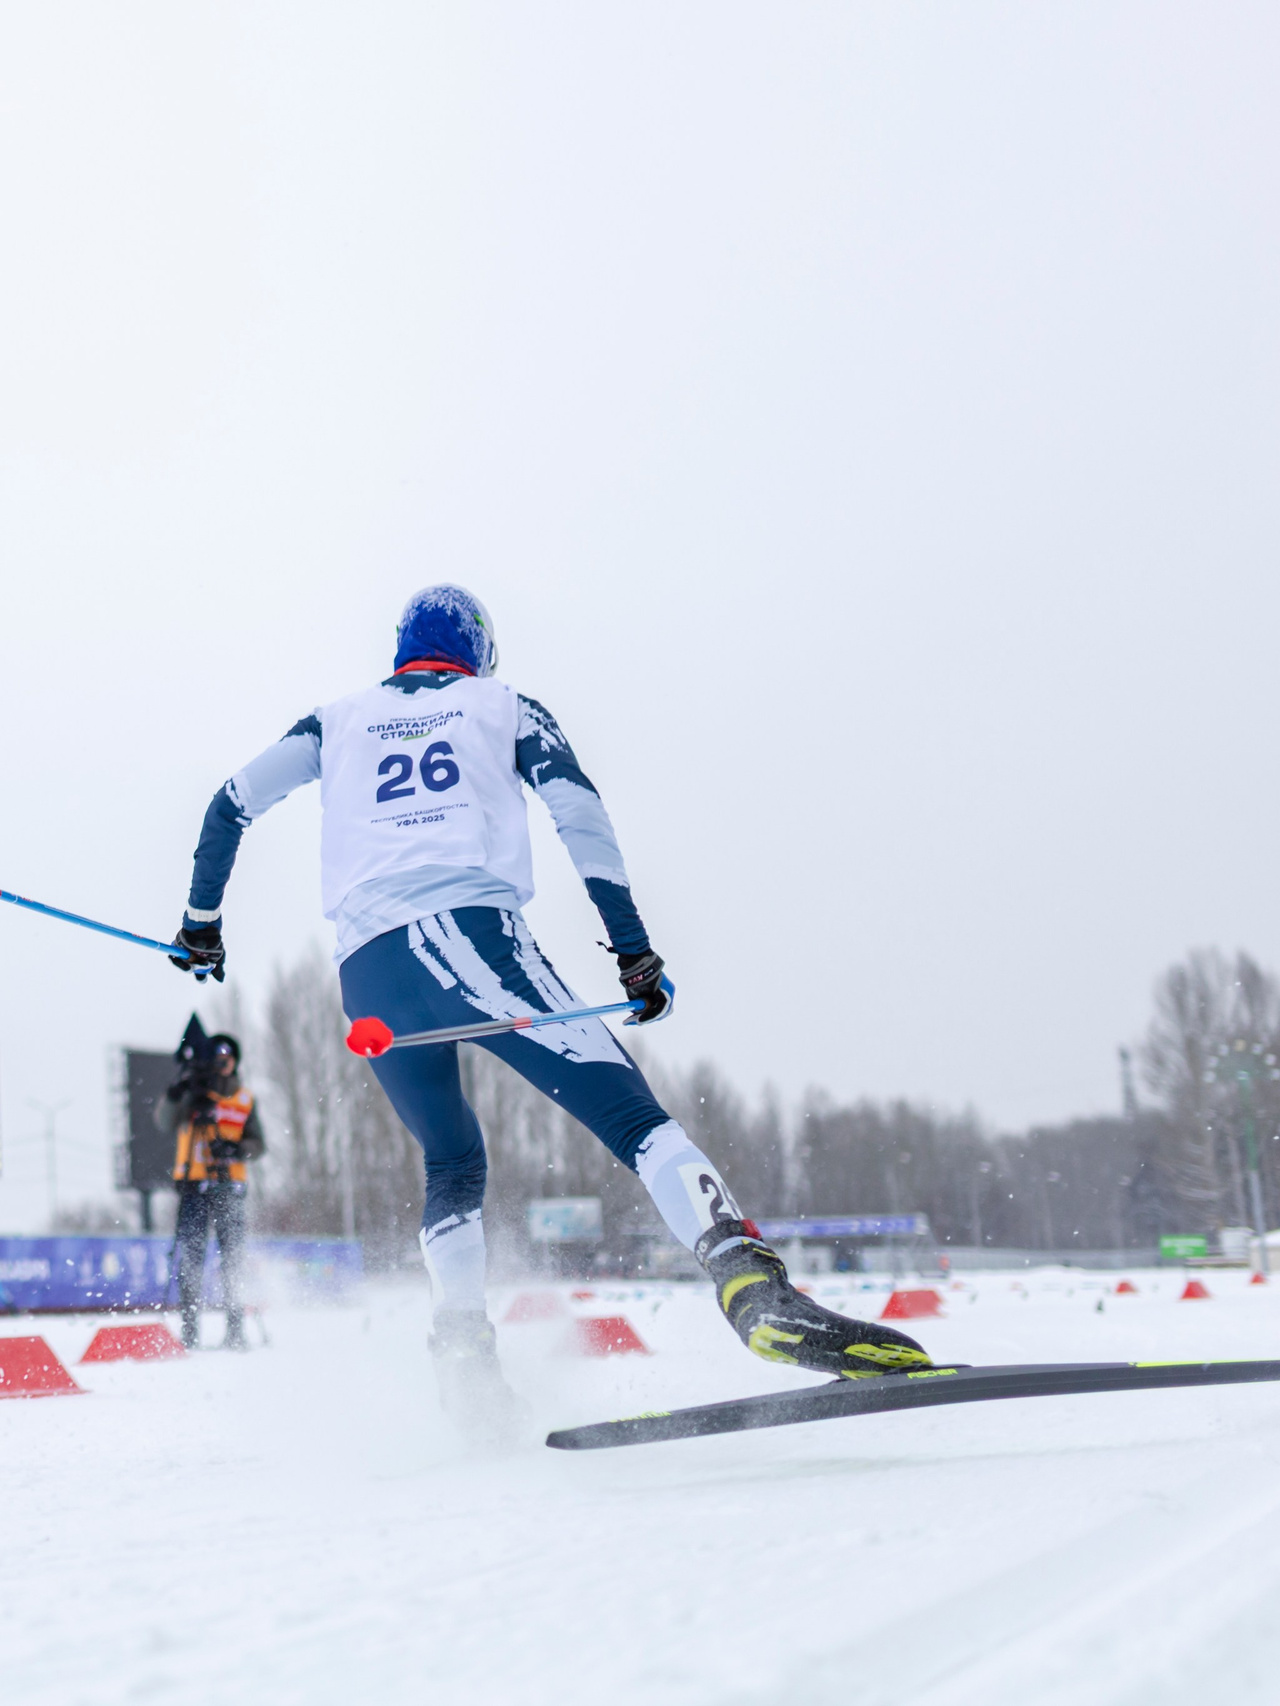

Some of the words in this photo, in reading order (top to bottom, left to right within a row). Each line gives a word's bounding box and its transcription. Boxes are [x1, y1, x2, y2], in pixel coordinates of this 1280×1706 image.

[367, 710, 464, 733] СПАРТАКИАДА
[380, 729, 424, 740] СТРАН
[427, 718, 451, 732] СНГ
[376, 740, 460, 804] 26
[370, 812, 413, 824] РЕСПУБЛИКА
[415, 803, 469, 816] БАШКОРТОСТАН
[396, 818, 419, 828] УФА
[421, 813, 445, 824] 2025
[907, 1367, 958, 1380] FISCHER
